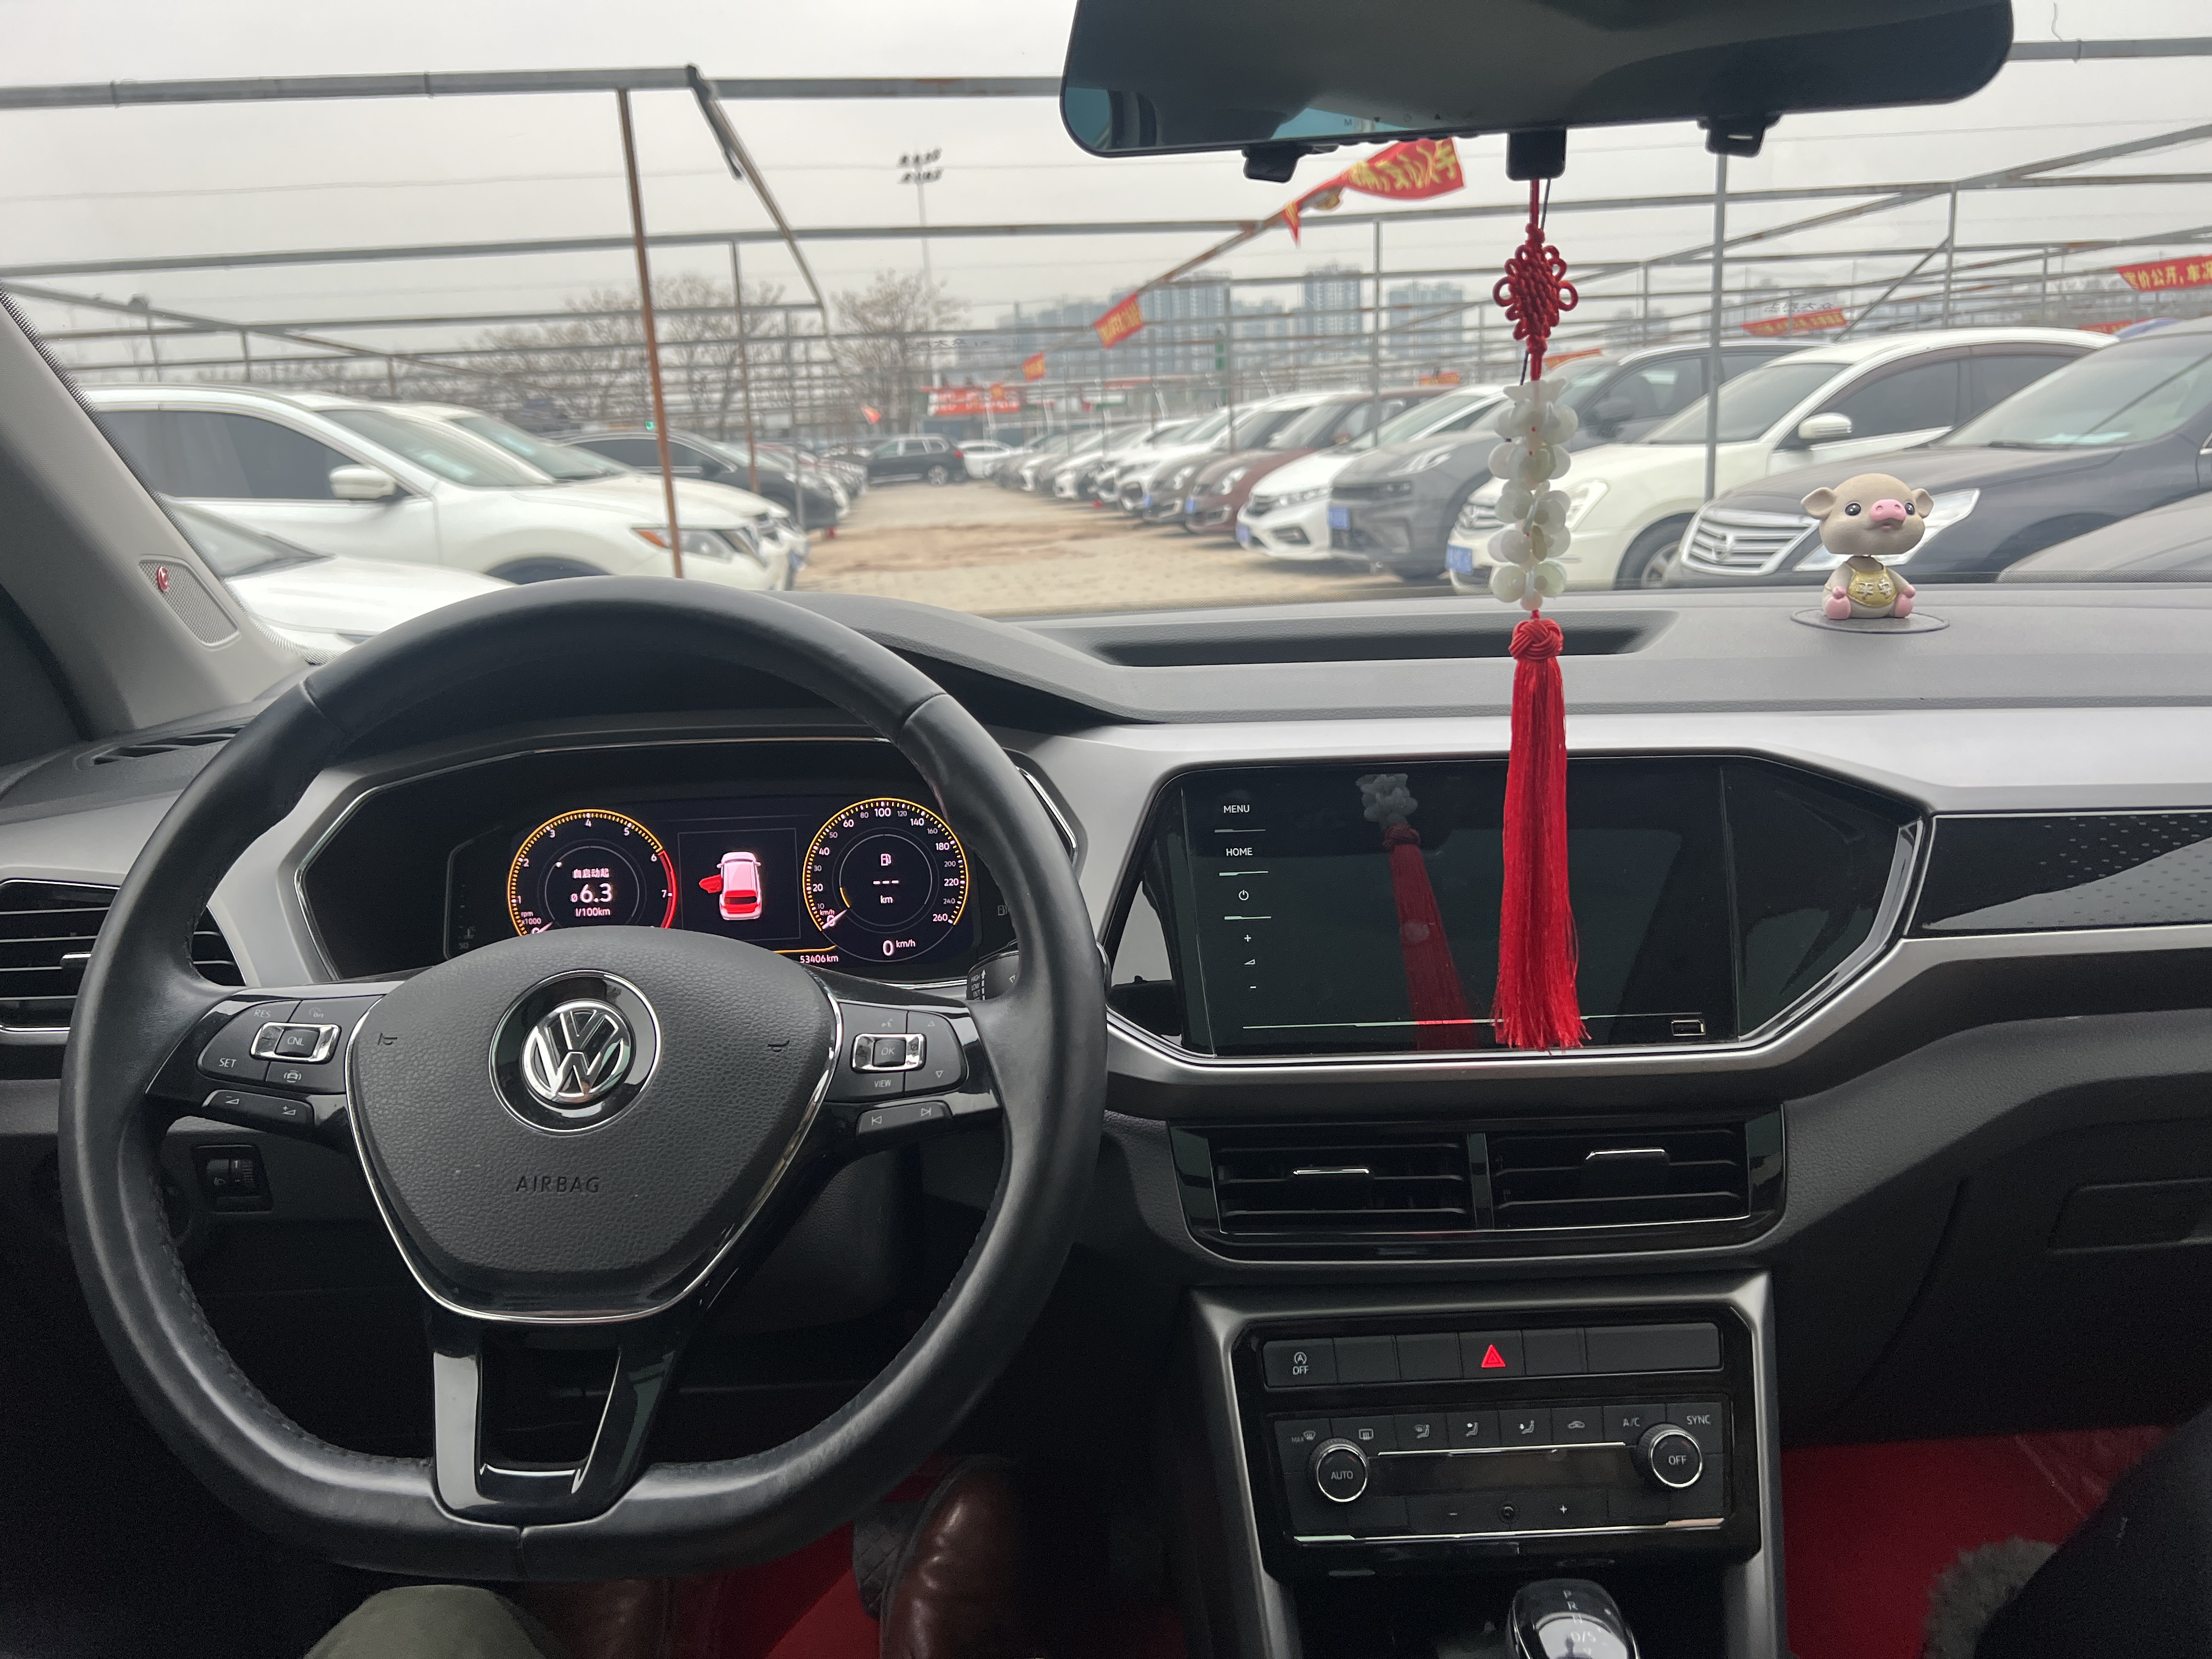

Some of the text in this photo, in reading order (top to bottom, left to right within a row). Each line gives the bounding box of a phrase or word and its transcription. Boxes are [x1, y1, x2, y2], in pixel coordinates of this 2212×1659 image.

[1857, 578, 1892, 600] 平安
[874, 808, 891, 817] 100
[1223, 804, 1250, 814] MENU
[860, 811, 869, 819] 80
[585, 819, 592, 827] 4
[843, 819, 854, 828] 60
[910, 817, 924, 826] 140
[550, 829, 556, 838] 3
[624, 827, 630, 836] 5
[935, 842, 950, 851] 180
[819, 847, 830, 856] 40
[1226, 847, 1253, 857] HOME
[523, 858, 529, 867] 2
[651, 854, 657, 862] 6
[944, 878, 959, 887] 220
[812, 883, 823, 892] 20
[580, 883, 612, 903] 6.3
[661, 889, 667, 898] 7
[517, 895, 522, 904] 1
[880, 895, 893, 904] km
[932, 913, 949, 922] 260
[883, 940, 916, 956] 0 km/h
[253, 1009, 272, 1018] RES
[287, 1036, 304, 1046] CNL
[881, 1047, 896, 1056] OK
[219, 1058, 238, 1069] SET
[874, 1079, 892, 1088] VIEW
[516, 1176, 601, 1194] AIRBAG
[1293, 1365, 1309, 1375] OFF
[1623, 1418, 1641, 1427] A/C
[1686, 1414, 1712, 1426] SYNC
[1668, 1455, 1688, 1466] OFF
[1330, 1470, 1353, 1481] AUTO
[1567, 1601, 1578, 1611] R
